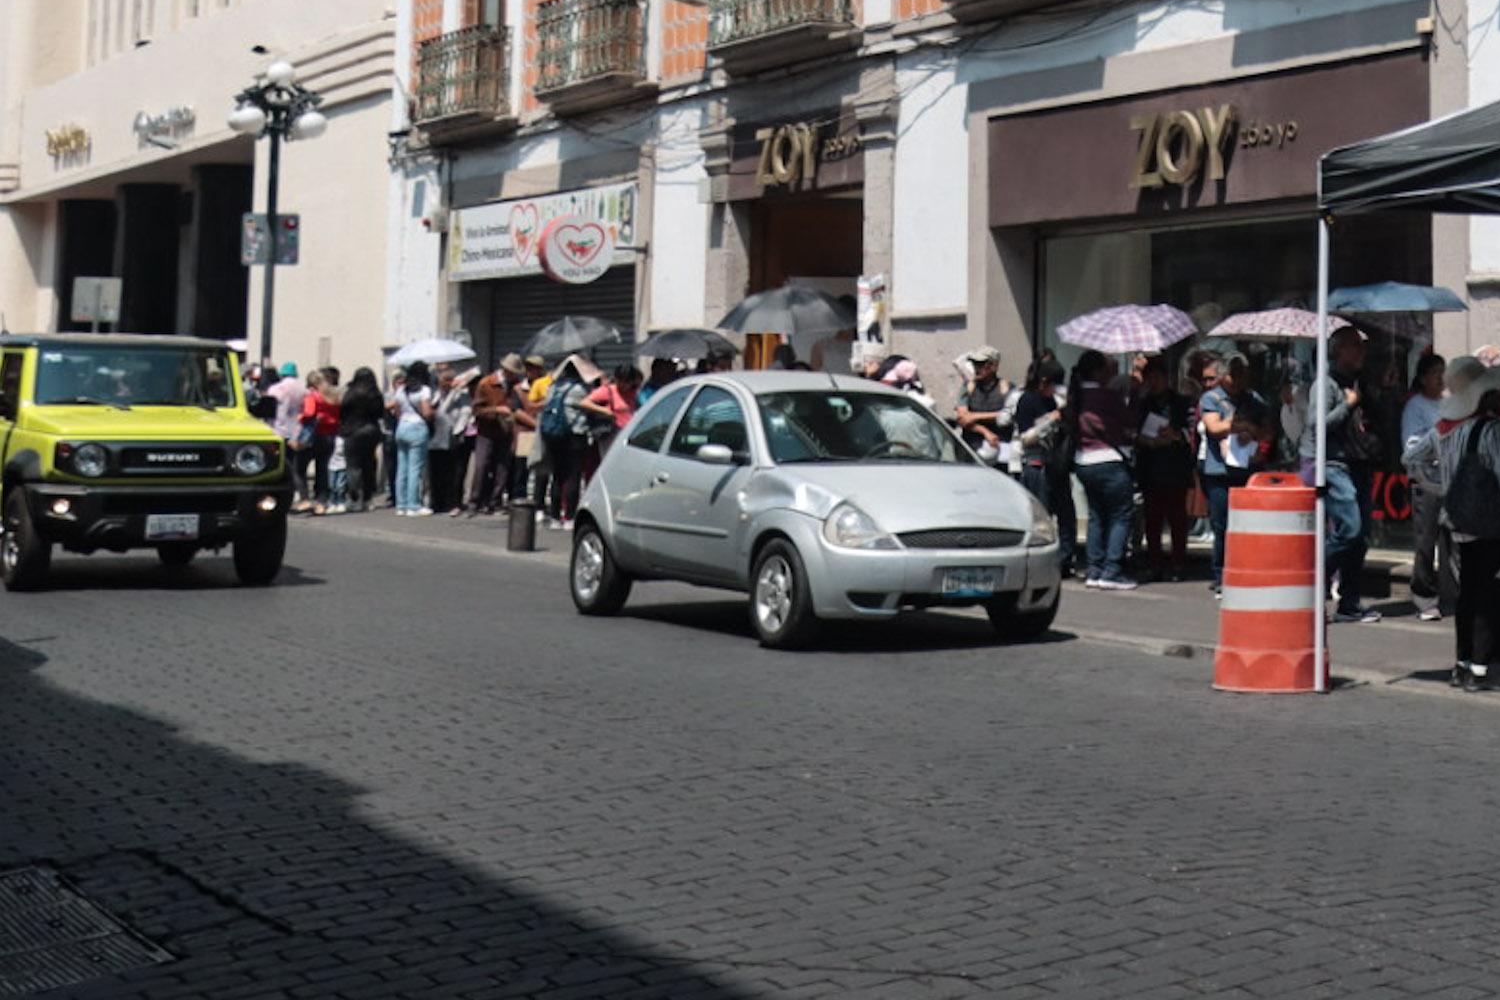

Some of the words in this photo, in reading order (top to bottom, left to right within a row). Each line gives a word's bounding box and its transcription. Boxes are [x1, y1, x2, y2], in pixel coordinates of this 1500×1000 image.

[756, 121, 816, 185] ZOY
[1129, 104, 1236, 190] ZOY
[147, 454, 200, 462] SUZUKI
